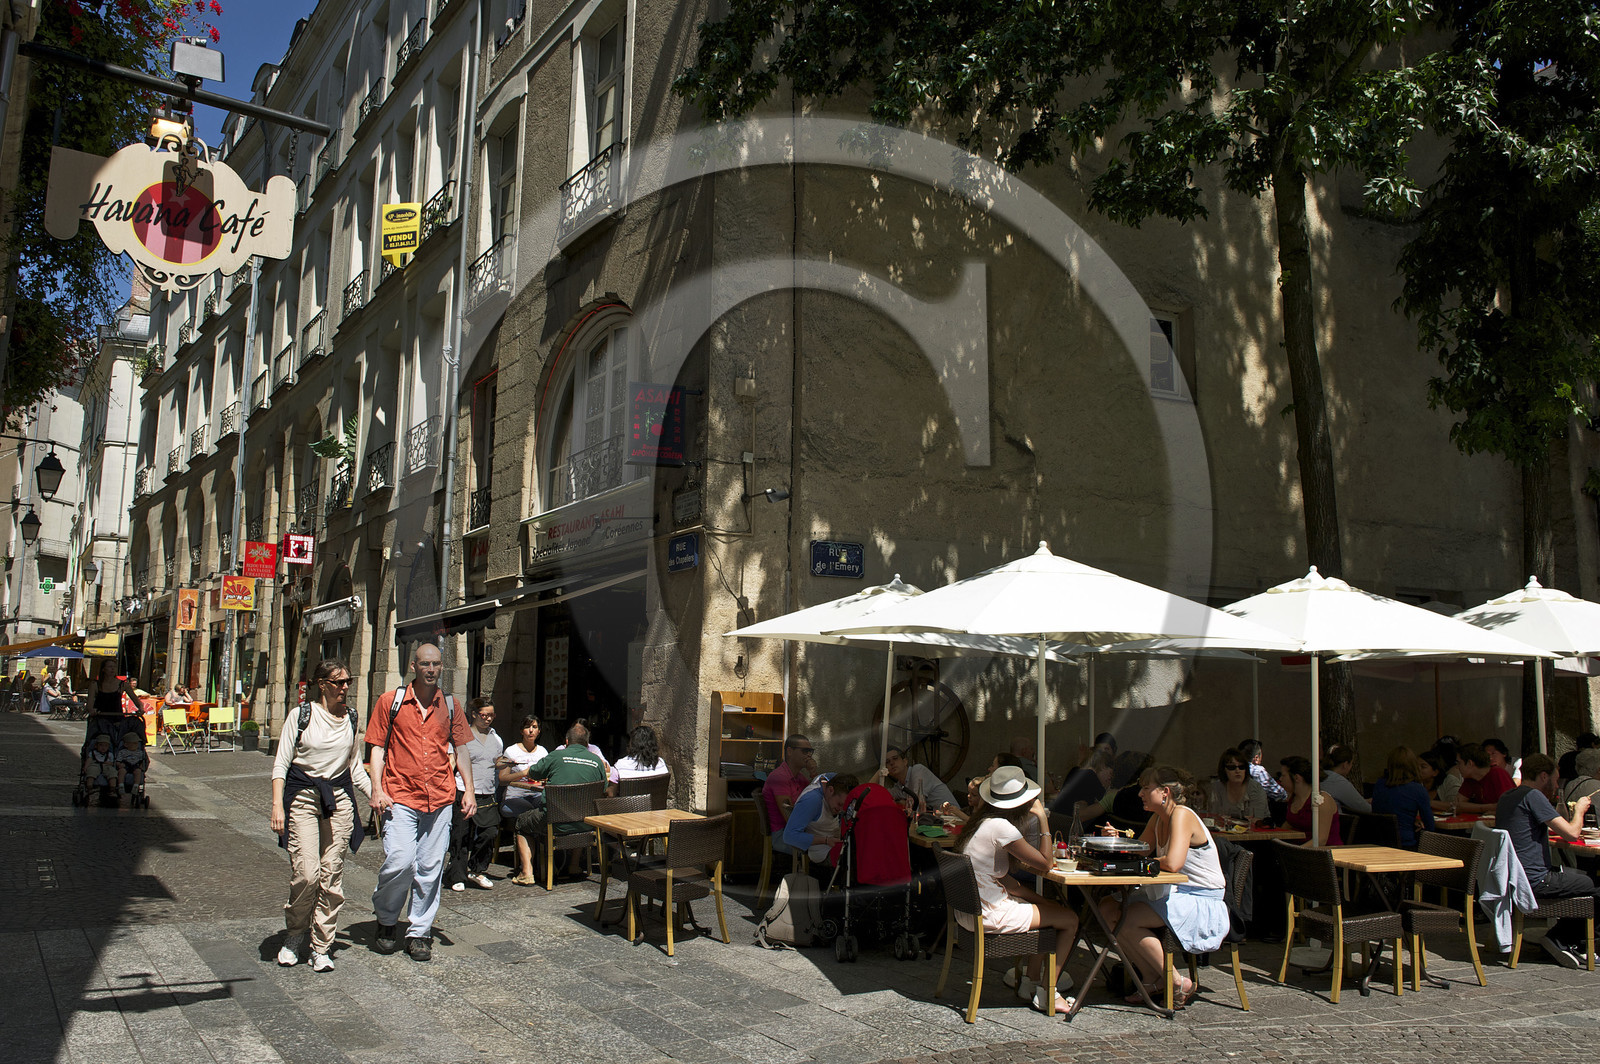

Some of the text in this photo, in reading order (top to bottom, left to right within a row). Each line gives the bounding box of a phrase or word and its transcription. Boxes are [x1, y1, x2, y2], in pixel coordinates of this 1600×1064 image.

[79, 183, 271, 254] Havana Café
[388, 233, 412, 242] VENDU
[635, 389, 681, 405] ASAHI
[548, 504, 625, 540] RESTAURANT ASAHI
[604, 520, 643, 540] Coréennes
[676, 542, 687, 552] RUE
[816, 561, 860, 573] de l'Emery
